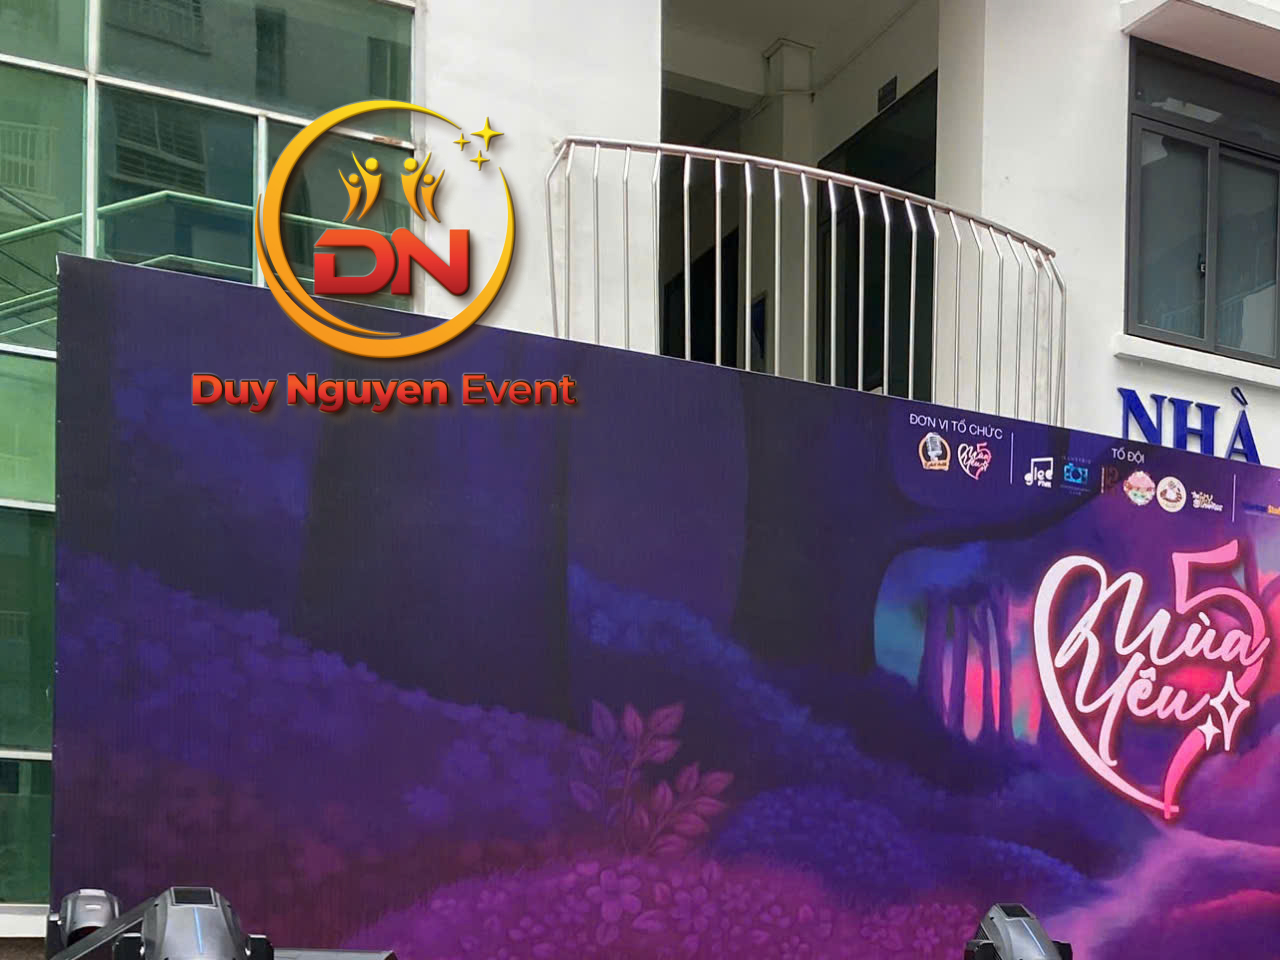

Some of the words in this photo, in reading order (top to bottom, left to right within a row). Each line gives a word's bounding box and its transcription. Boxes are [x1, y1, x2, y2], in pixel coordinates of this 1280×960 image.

[909, 413, 936, 428] ĐƠN
[938, 418, 949, 432] VỊ
[968, 424, 1003, 440] CHỨC
[1117, 386, 1261, 465] NHÀ
[1038, 555, 1271, 667] Mùa
